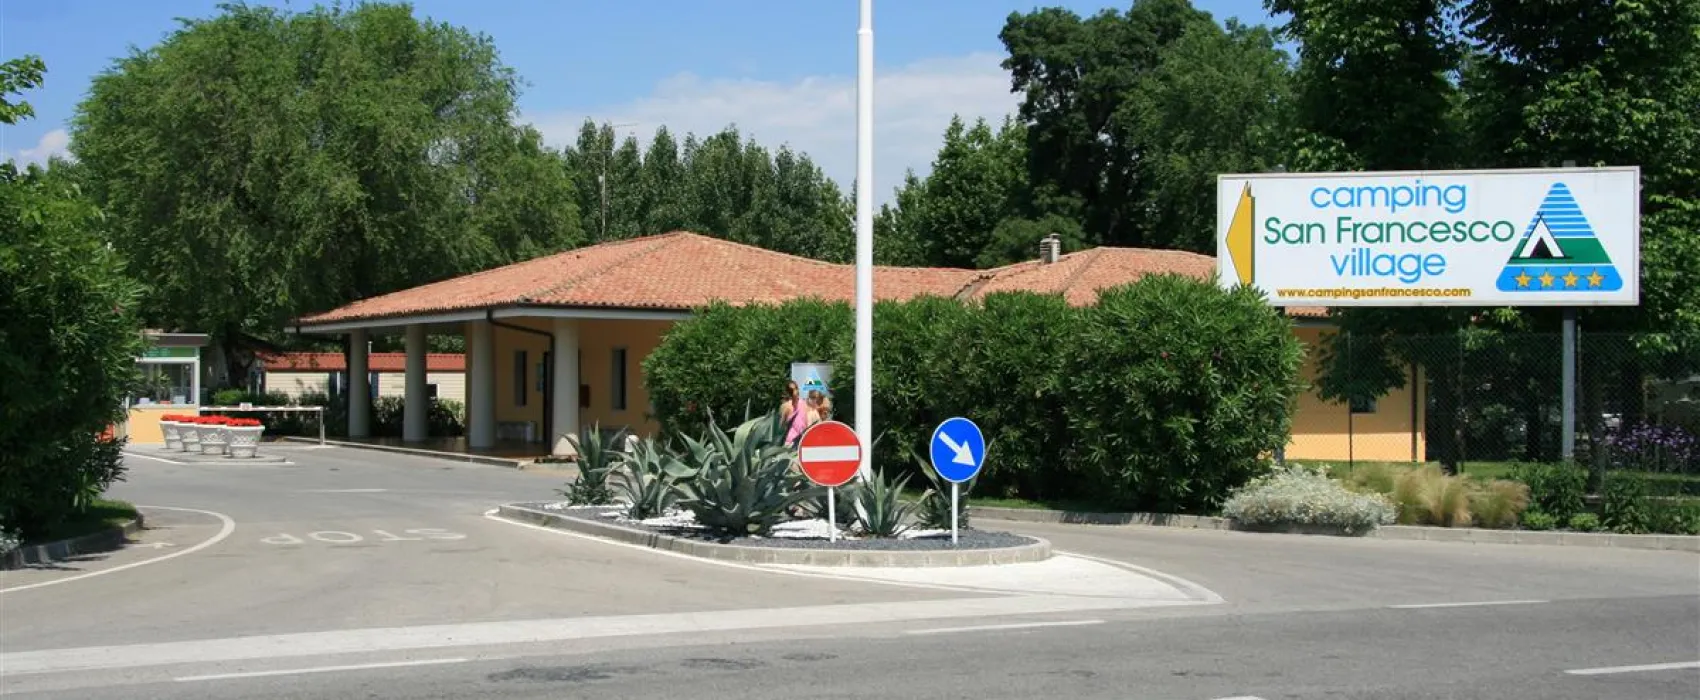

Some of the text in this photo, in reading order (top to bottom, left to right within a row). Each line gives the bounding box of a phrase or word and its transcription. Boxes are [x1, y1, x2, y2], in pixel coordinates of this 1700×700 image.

[1310, 180, 1466, 213] camping
[1264, 216, 1516, 244] San Francesco
[1330, 248, 1446, 283] village
[1277, 286, 1471, 299] www.campingsanfrancesco.com
[261, 529, 467, 545] STOP
